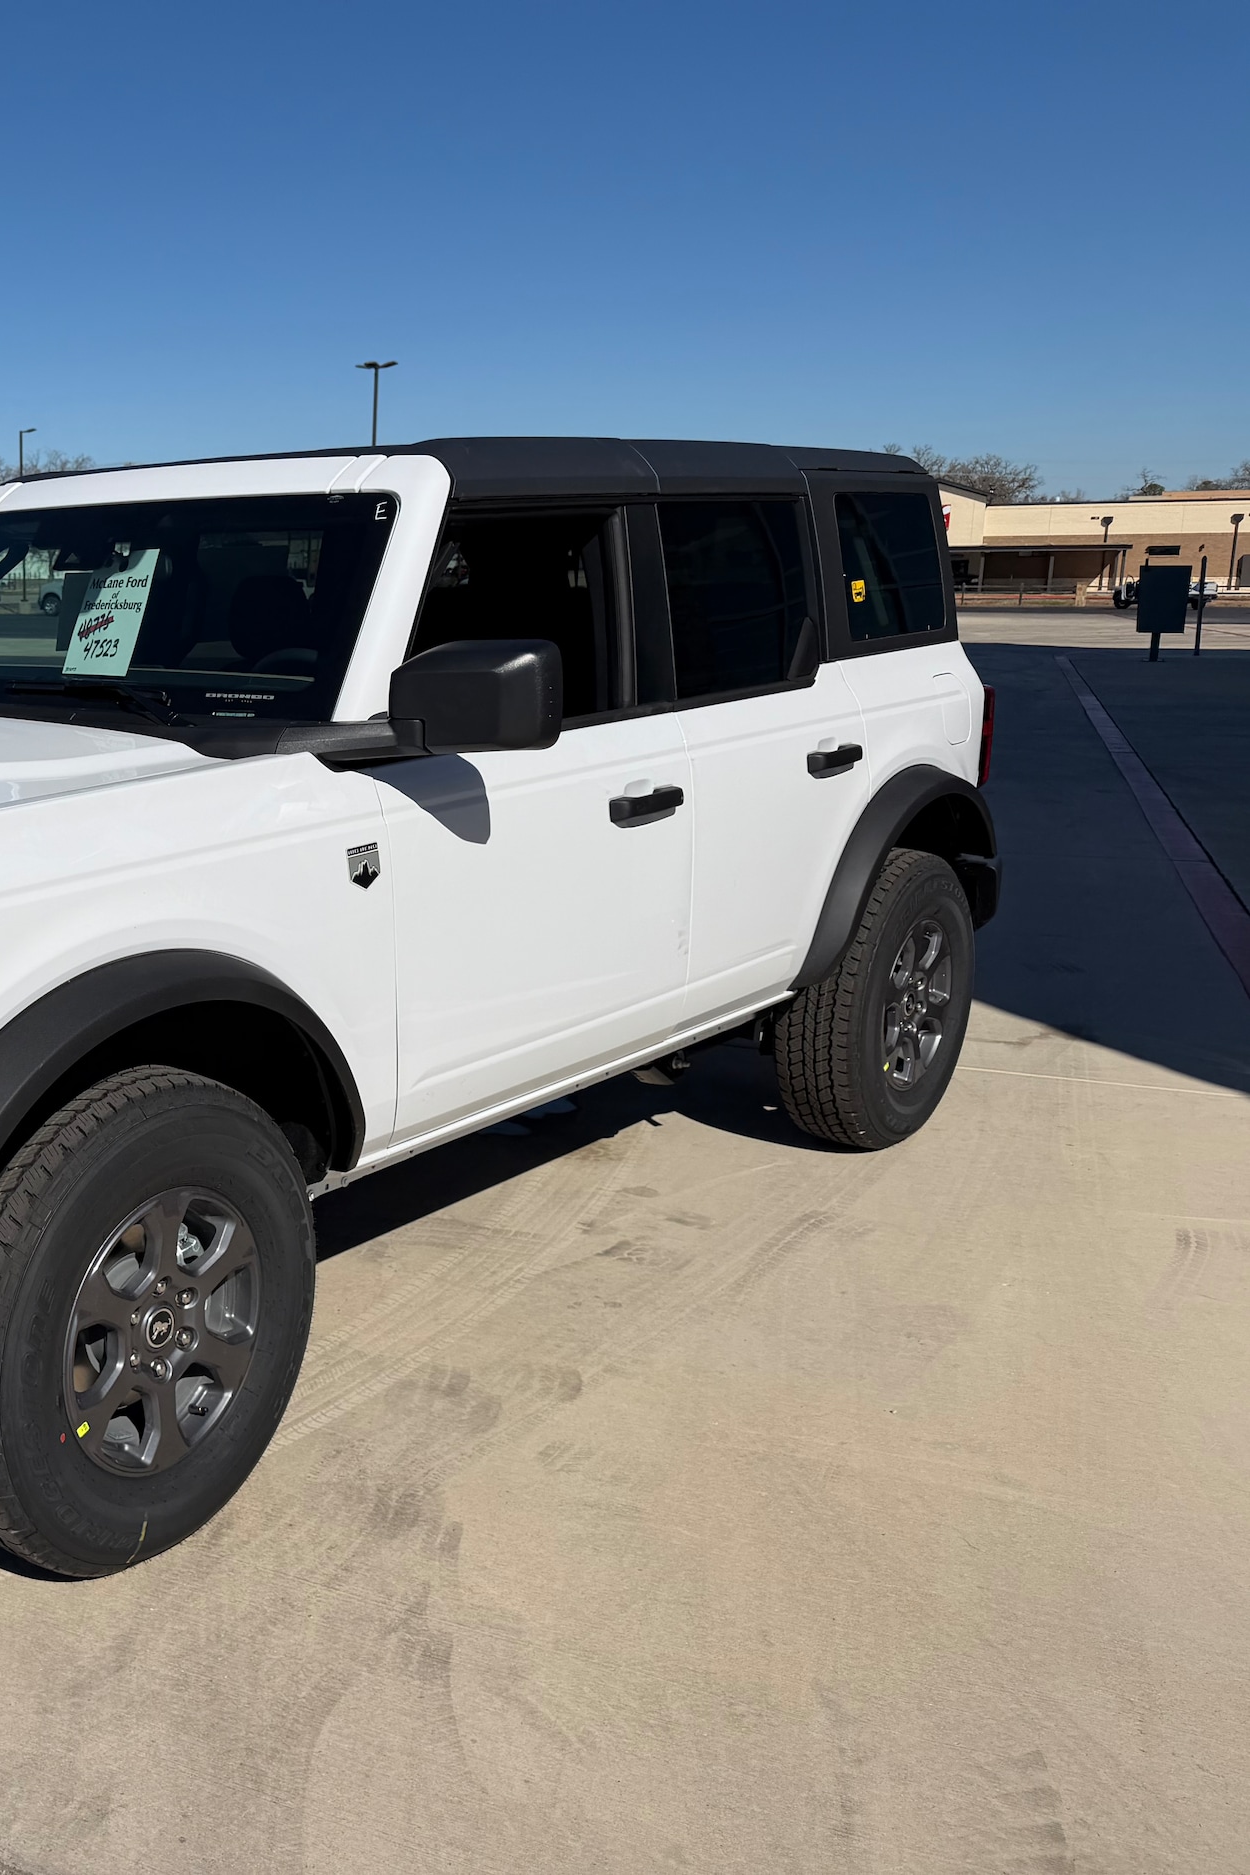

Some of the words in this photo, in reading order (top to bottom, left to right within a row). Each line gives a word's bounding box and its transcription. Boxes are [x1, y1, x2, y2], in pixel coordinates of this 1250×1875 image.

[375, 501, 388, 520] E
[90, 577, 124, 589] McLane
[125, 575, 149, 588] Ford
[111, 590, 120, 599] of
[83, 599, 143, 613] Fredericksburg
[83, 638, 120, 661] 47523
